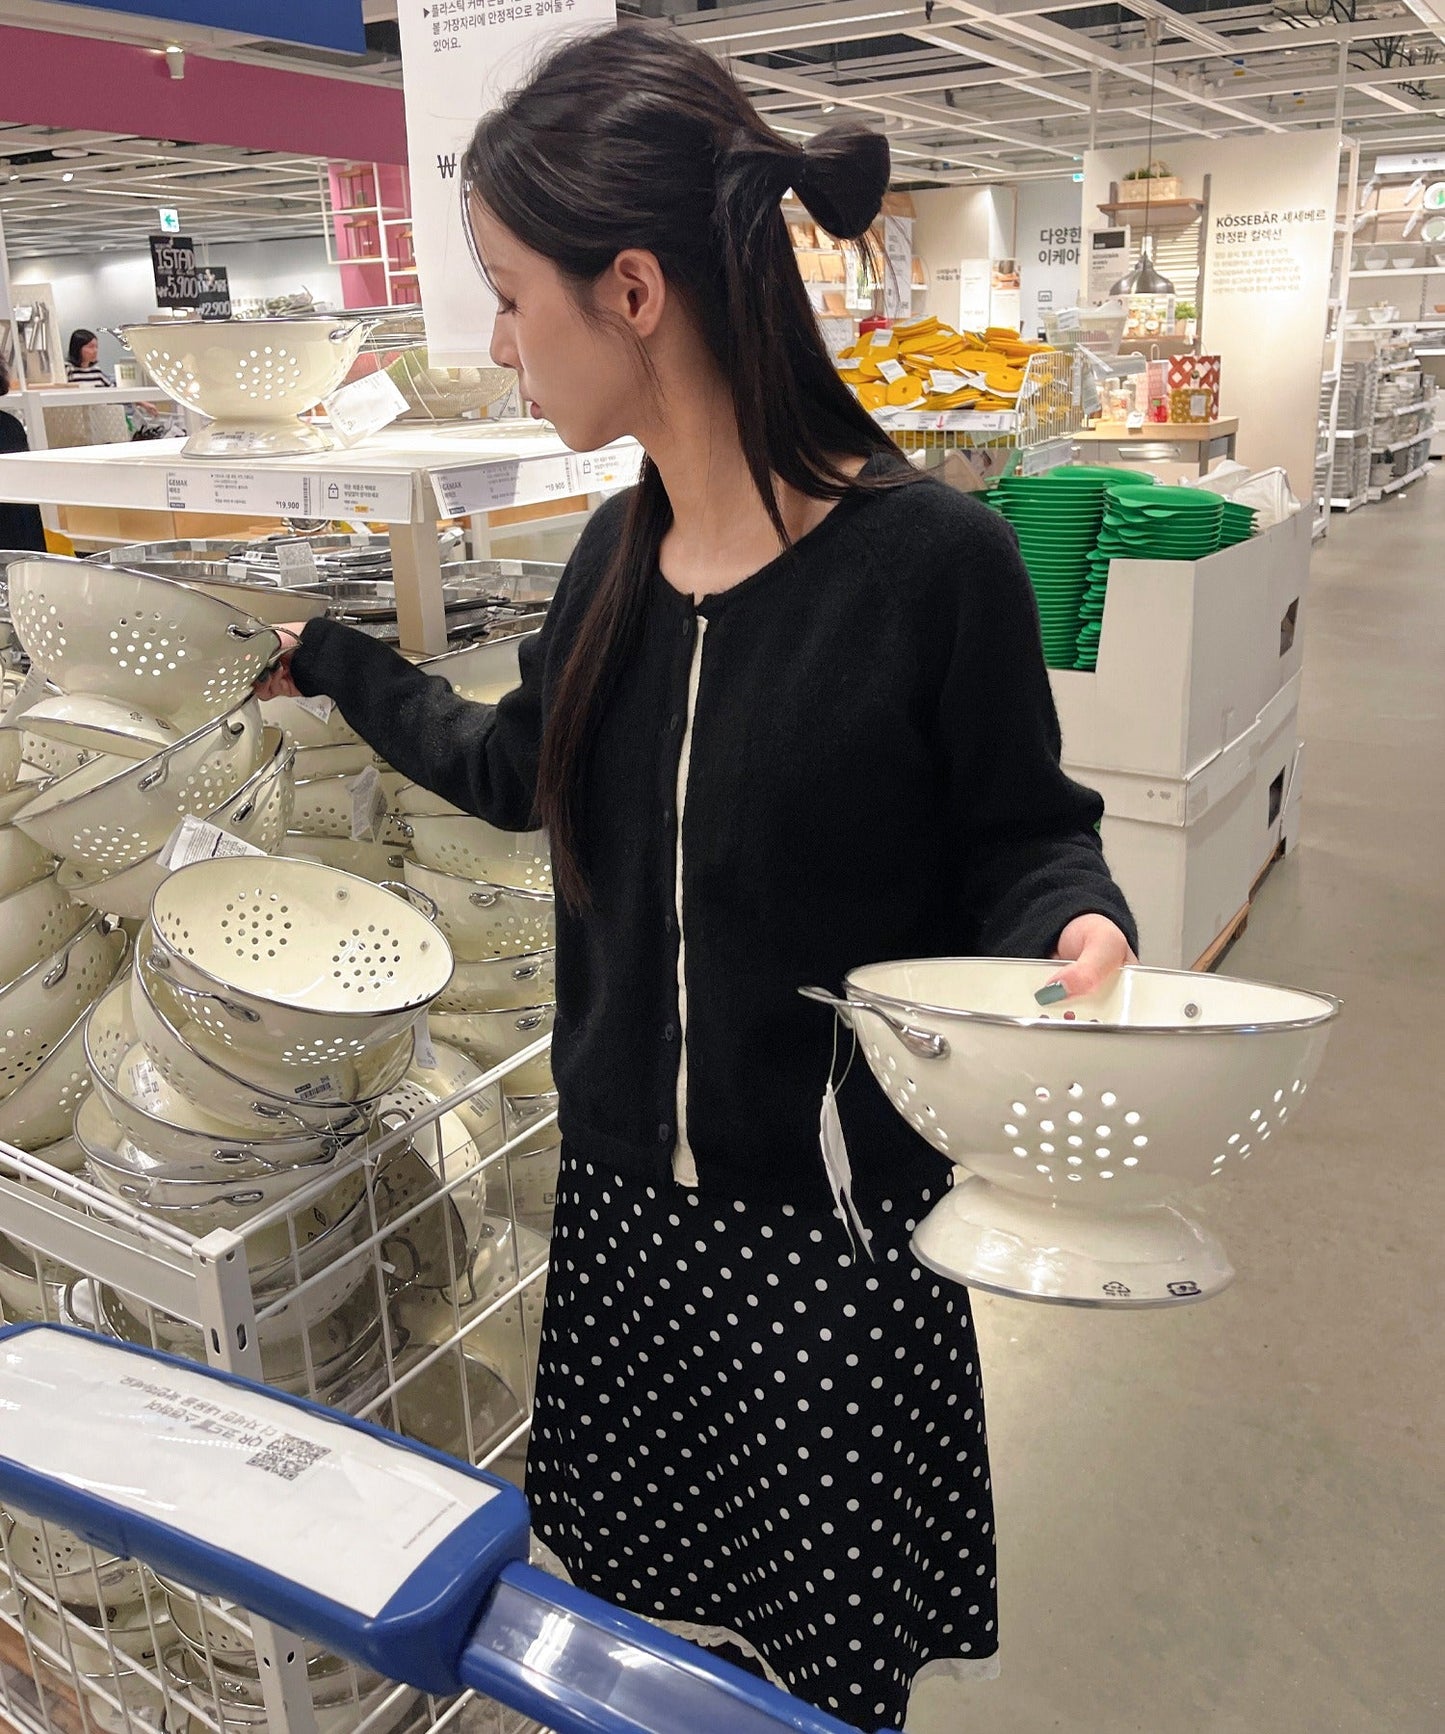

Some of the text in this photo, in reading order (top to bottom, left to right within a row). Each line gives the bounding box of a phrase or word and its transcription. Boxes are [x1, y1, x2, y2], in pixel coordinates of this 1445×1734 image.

[432, 0, 465, 18] 플라스틱
[443, 14, 486, 33] 가장자리에
[488, 5, 532, 25] 안정적으로
[535, 0, 563, 17] 걸어둘
[565, 0, 576, 11] 수
[433, 37, 461, 53] 있어요.
[1216, 211, 1278, 228] KÖSSEBÄR
[1215, 228, 1282, 244] 한정판 컬렉션
[156, 248, 195, 271] ISTAD
[180, 1396, 221, 1416] 내용을
[221, 1411, 260, 1430] 자세한
[260, 1425, 277, 1437] 더
[238, 1434, 263, 1447] QR
